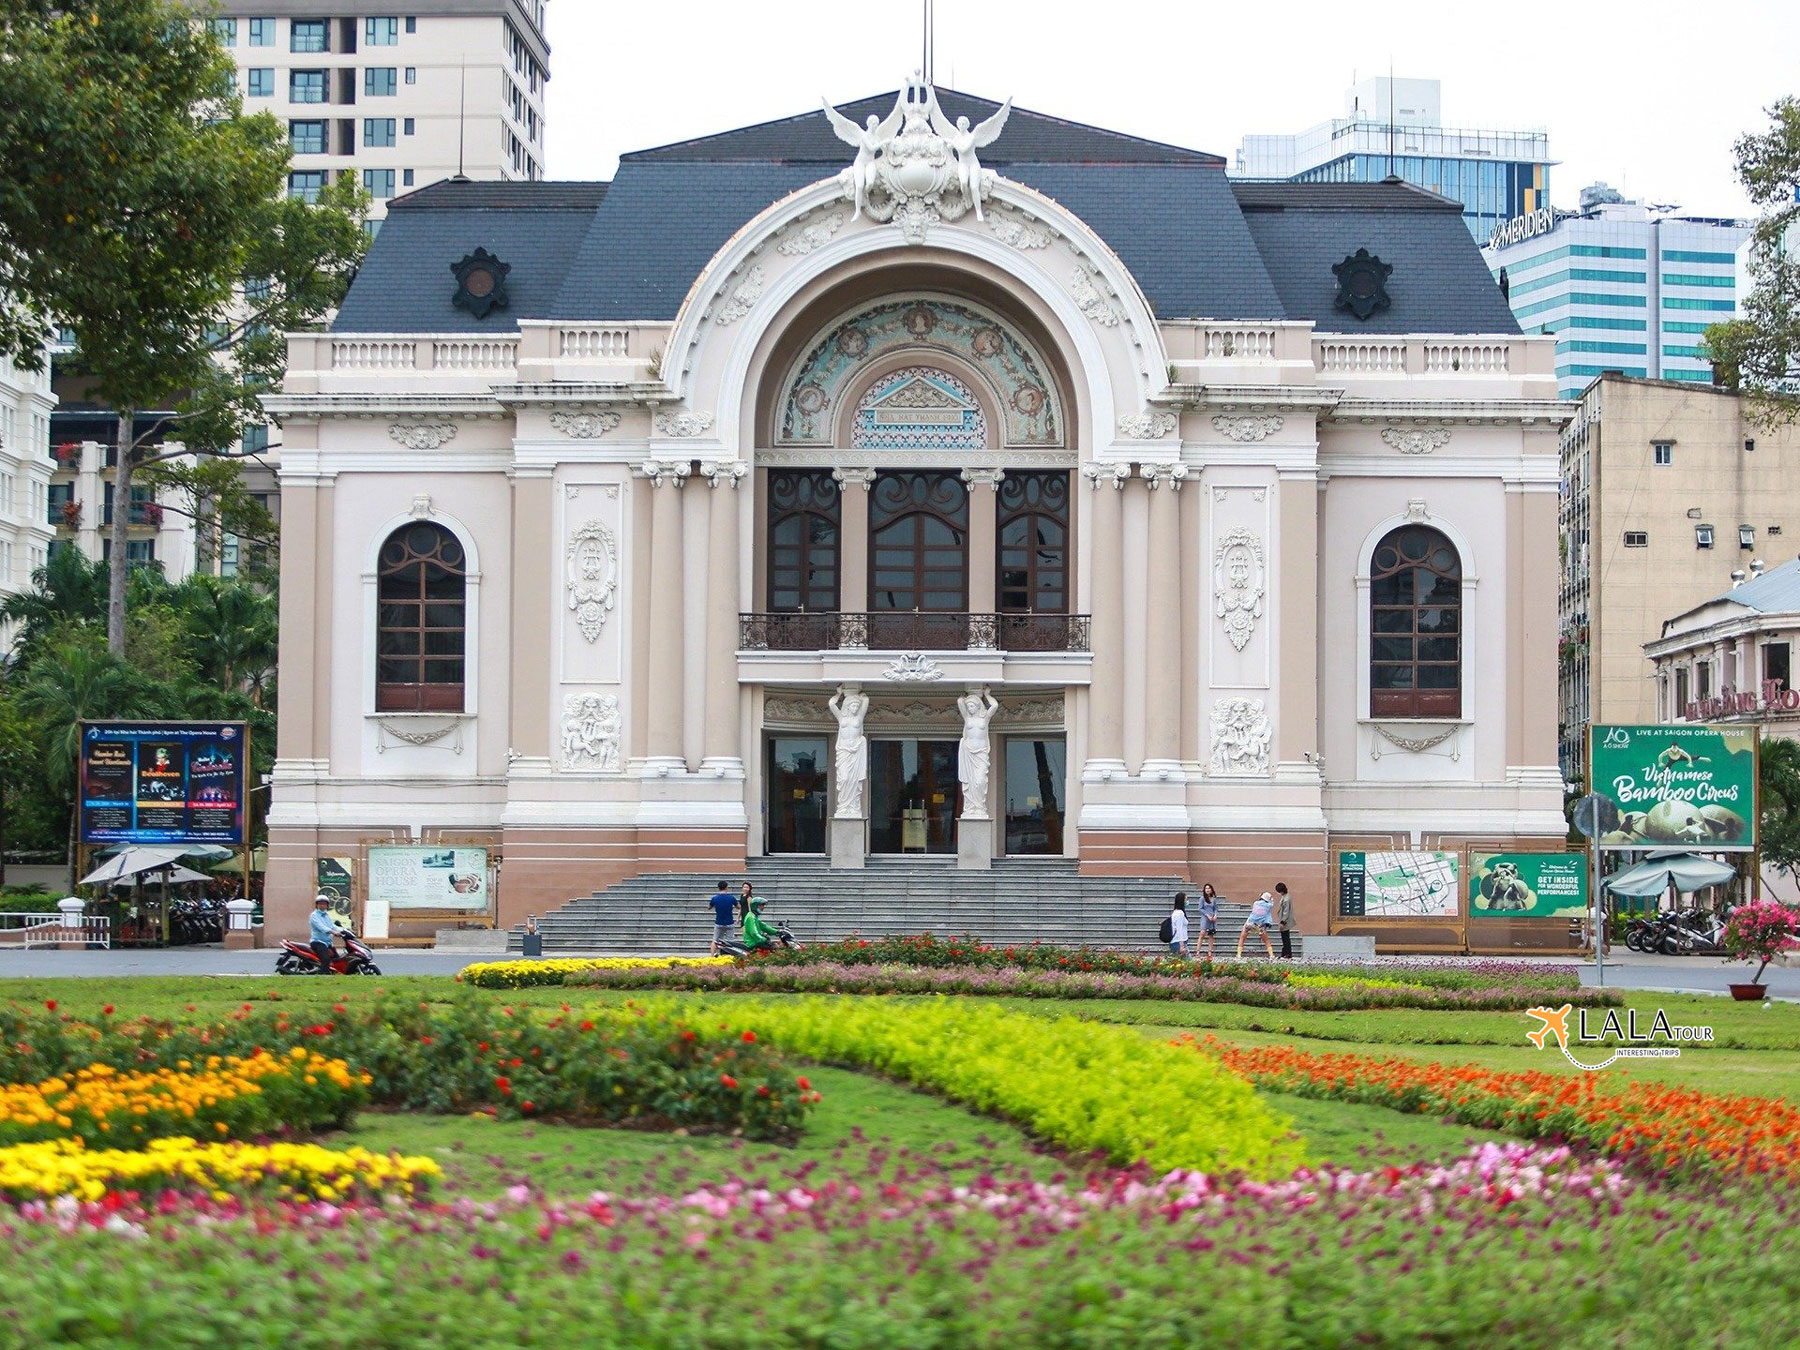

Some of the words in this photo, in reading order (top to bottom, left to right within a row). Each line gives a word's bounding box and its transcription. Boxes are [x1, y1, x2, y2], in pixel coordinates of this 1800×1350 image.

[1502, 207, 1554, 247] MERIDIEN
[1642, 763, 1713, 784] Vietnamese
[1613, 775, 1696, 803] Bamboo
[1696, 782, 1739, 802] Circus
[375, 858, 417, 866] SAIGON
[375, 867, 417, 876] OPERA
[376, 876, 417, 886] HOUSE
